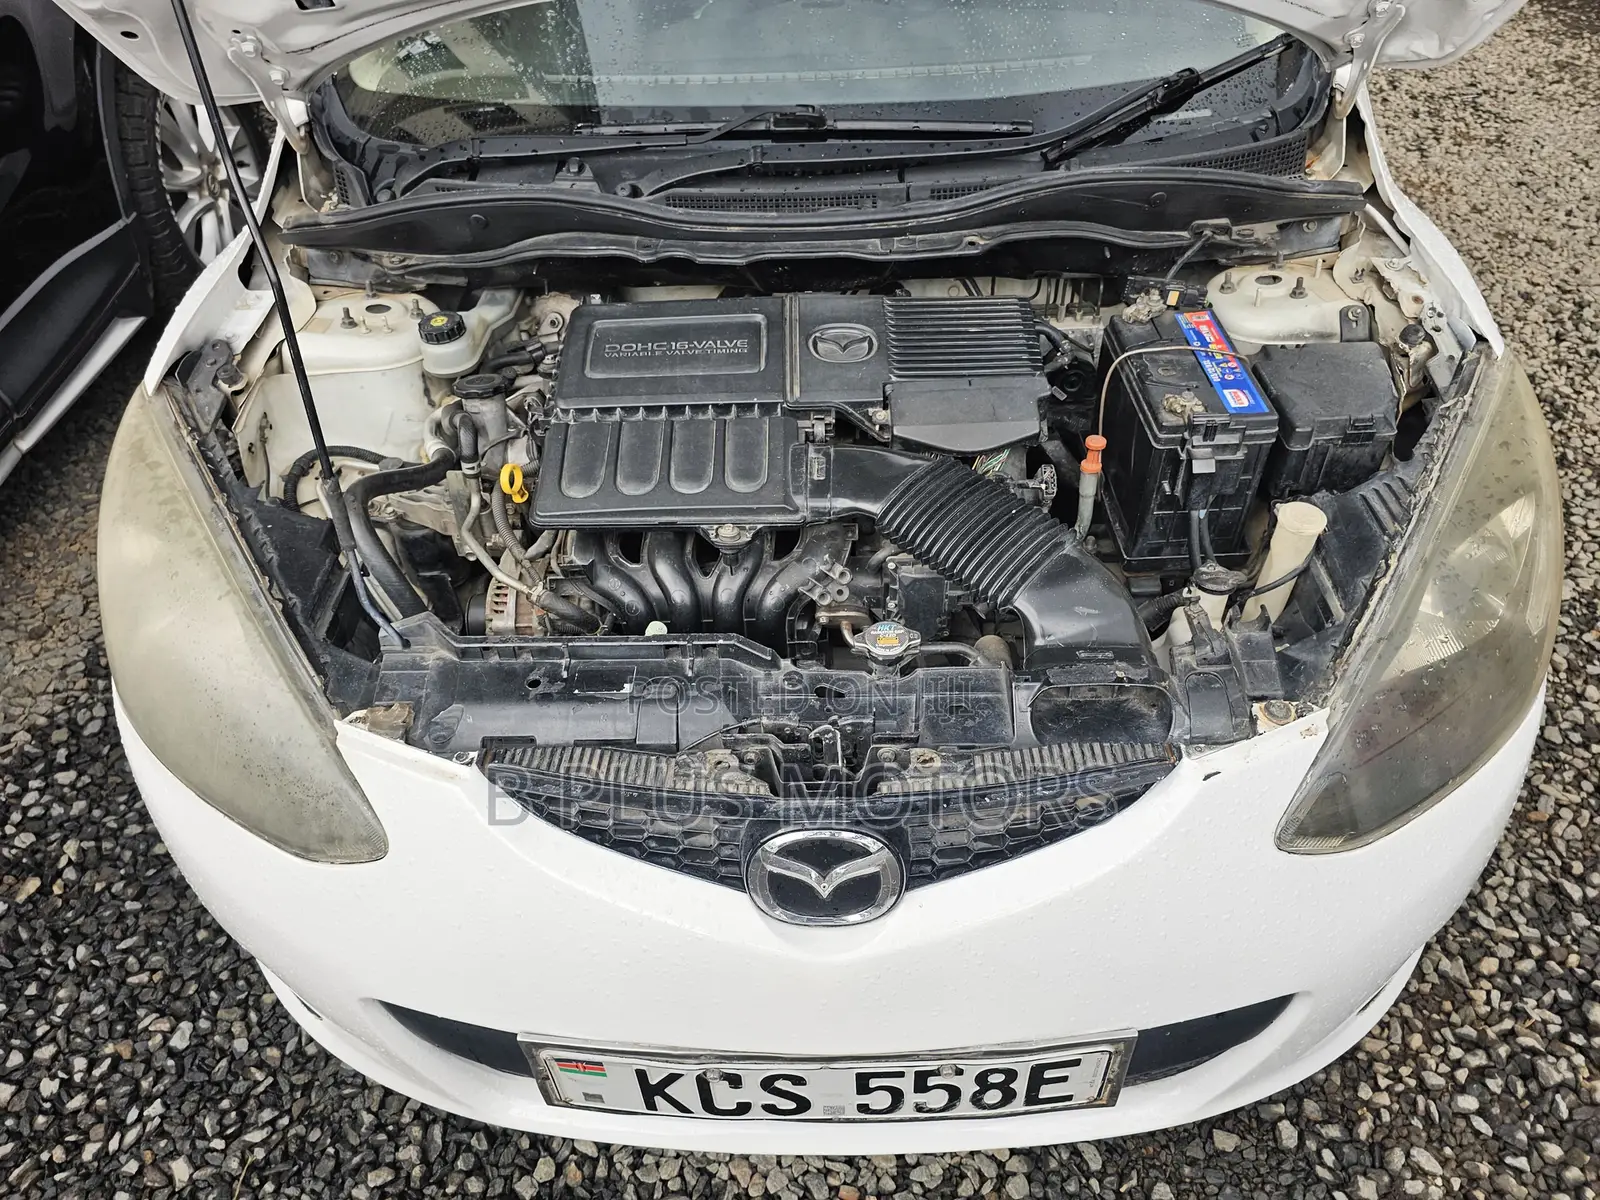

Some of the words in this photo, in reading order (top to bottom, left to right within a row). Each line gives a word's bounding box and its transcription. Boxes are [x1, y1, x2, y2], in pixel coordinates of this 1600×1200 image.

[605, 341, 667, 352] DOHC
[671, 339, 749, 351] 16-VALVE
[604, 350, 662, 358] VARIABLE
[634, 1068, 812, 1117] KCS
[855, 1058, 1082, 1115] 558E
